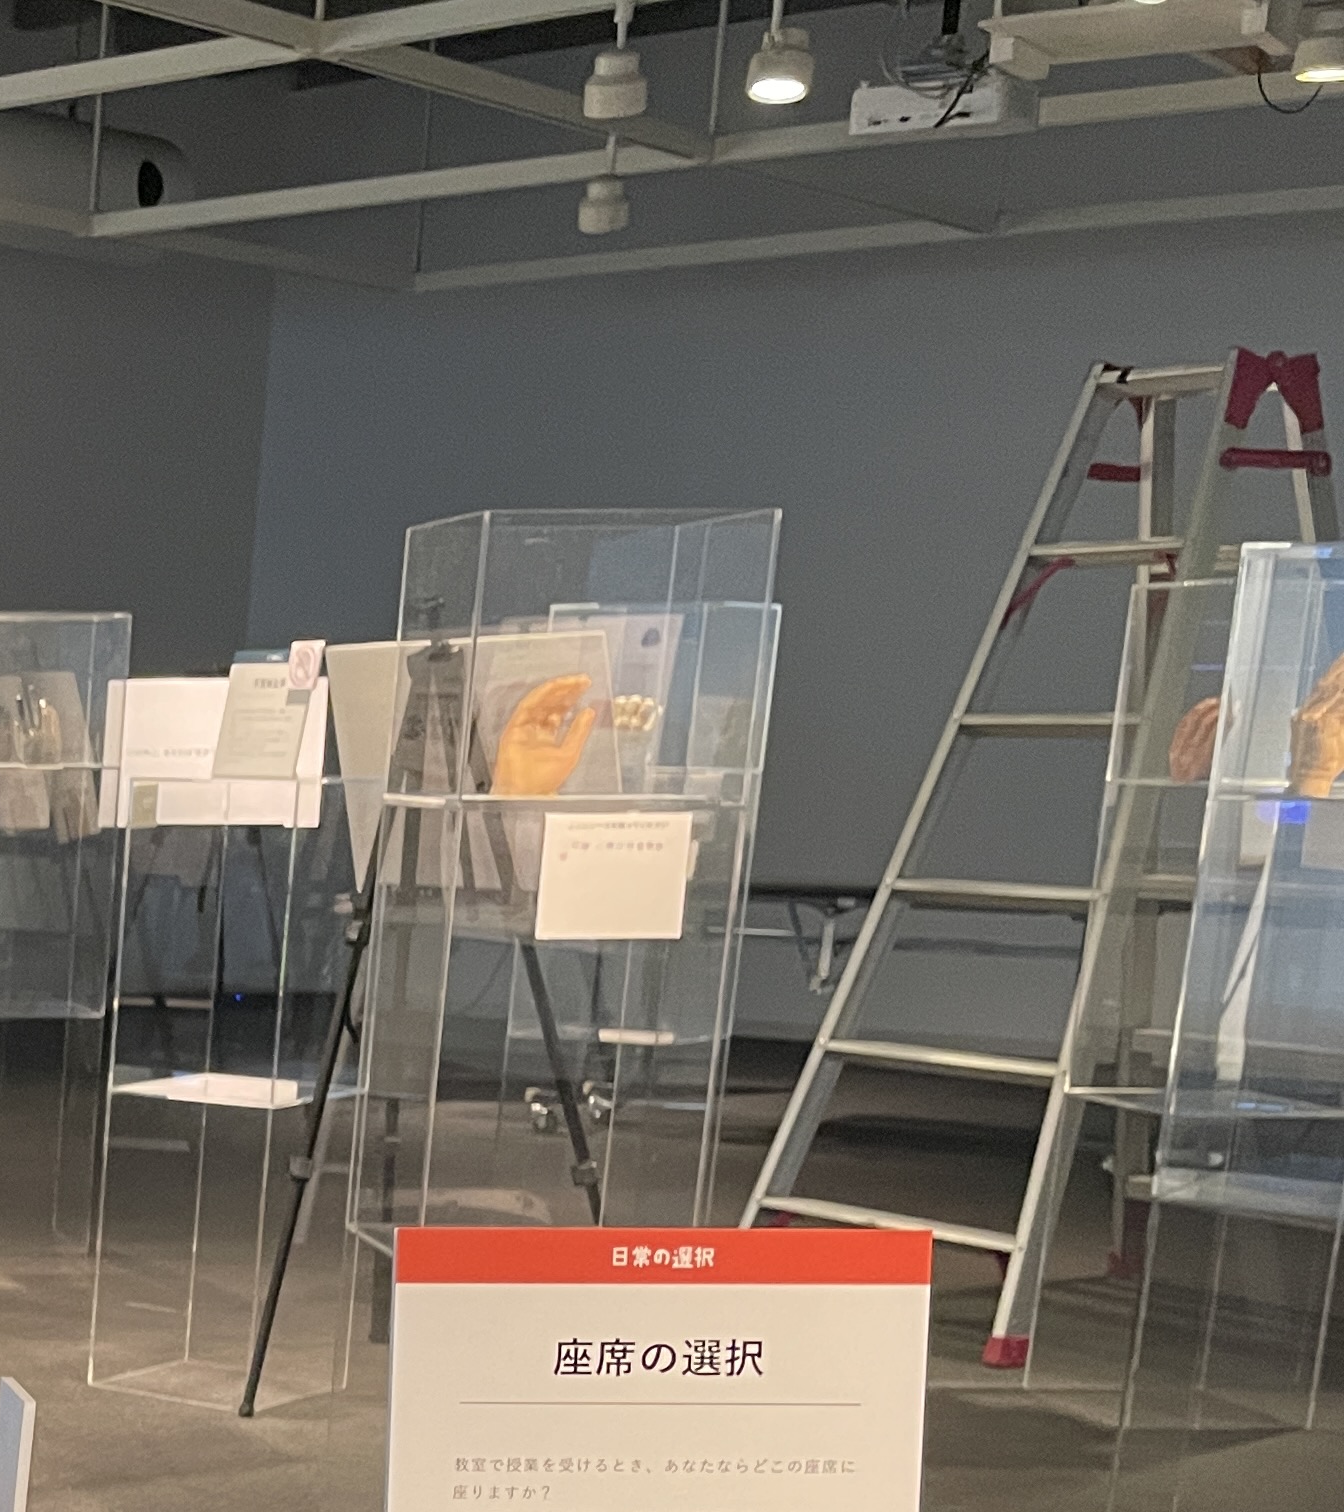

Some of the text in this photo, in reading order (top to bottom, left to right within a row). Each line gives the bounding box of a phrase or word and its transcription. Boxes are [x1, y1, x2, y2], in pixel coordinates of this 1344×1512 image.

[612, 1245, 715, 1269] 日常の選択
[553, 1337, 764, 1377] 座席の選択
[455, 1457, 856, 1474] 教室で授業を受けるとき、あなたならどこの座席に
